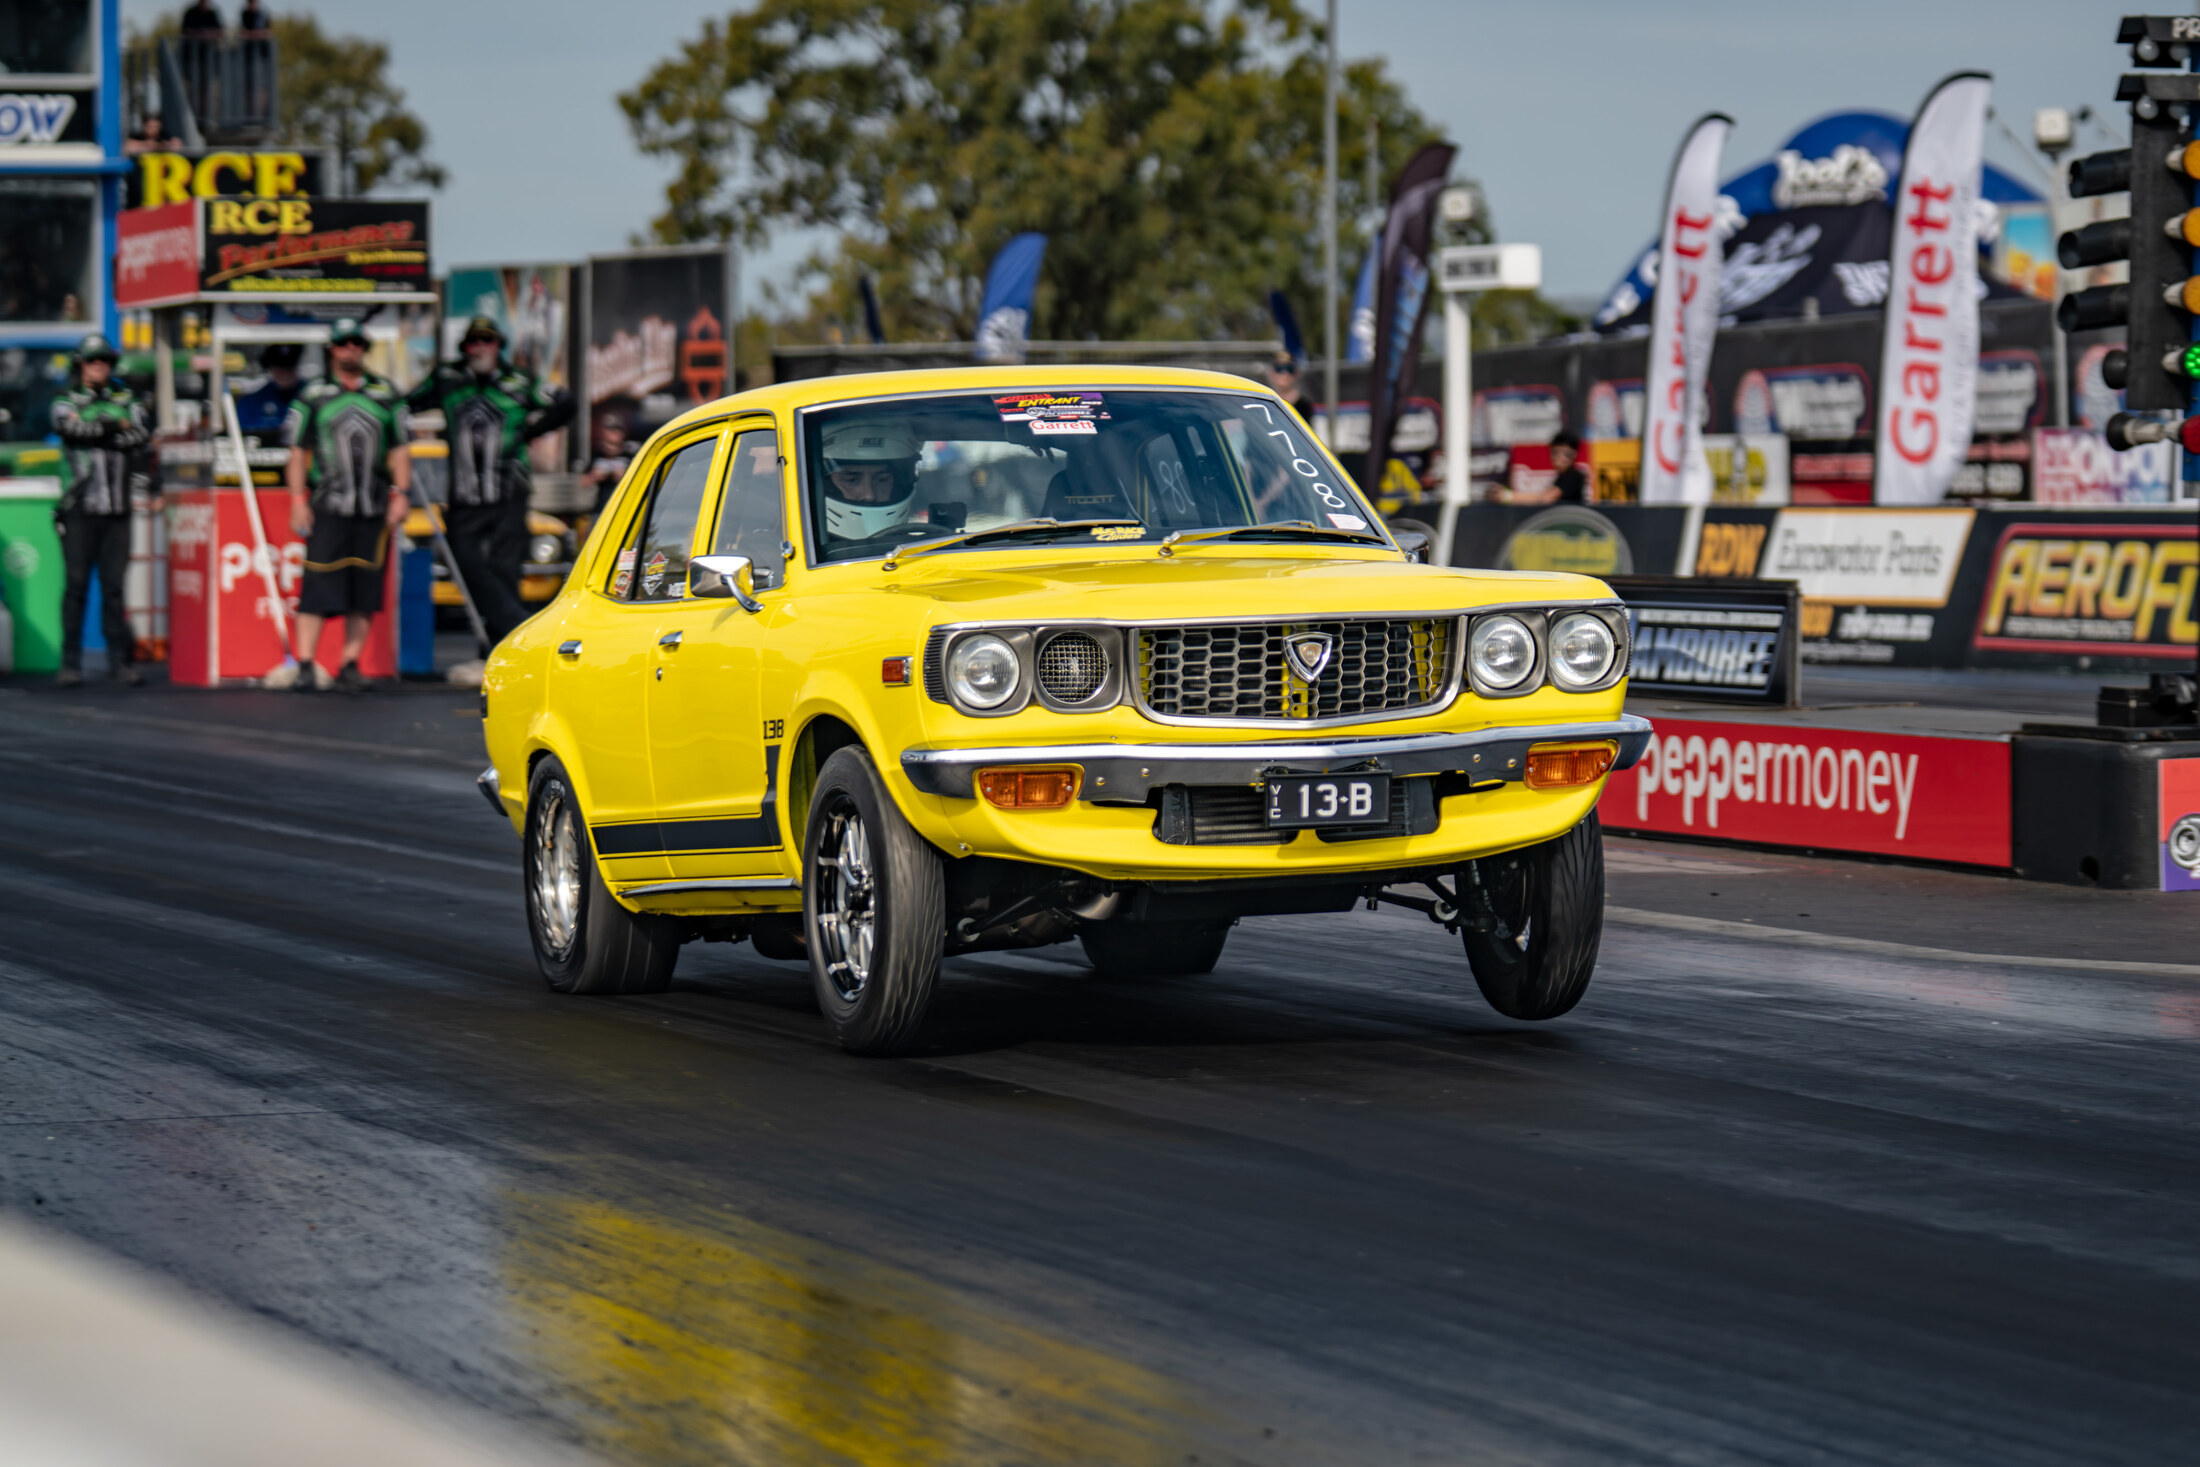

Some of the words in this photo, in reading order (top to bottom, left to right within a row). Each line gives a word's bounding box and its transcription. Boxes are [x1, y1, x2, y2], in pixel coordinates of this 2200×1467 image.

[210, 200, 314, 235] RCE
[218, 220, 415, 272] Performance
[1891, 178, 1954, 465] Garrett
[1017, 396, 1083, 408] ENTRANT
[1031, 420, 1096, 431] Garrett
[1242, 403, 1347, 509] 7708
[1776, 528, 1882, 577] Excavator
[1884, 530, 1944, 576] Parts
[1269, 783, 1282, 820] VIC
[1637, 734, 1920, 840] peppermoney
